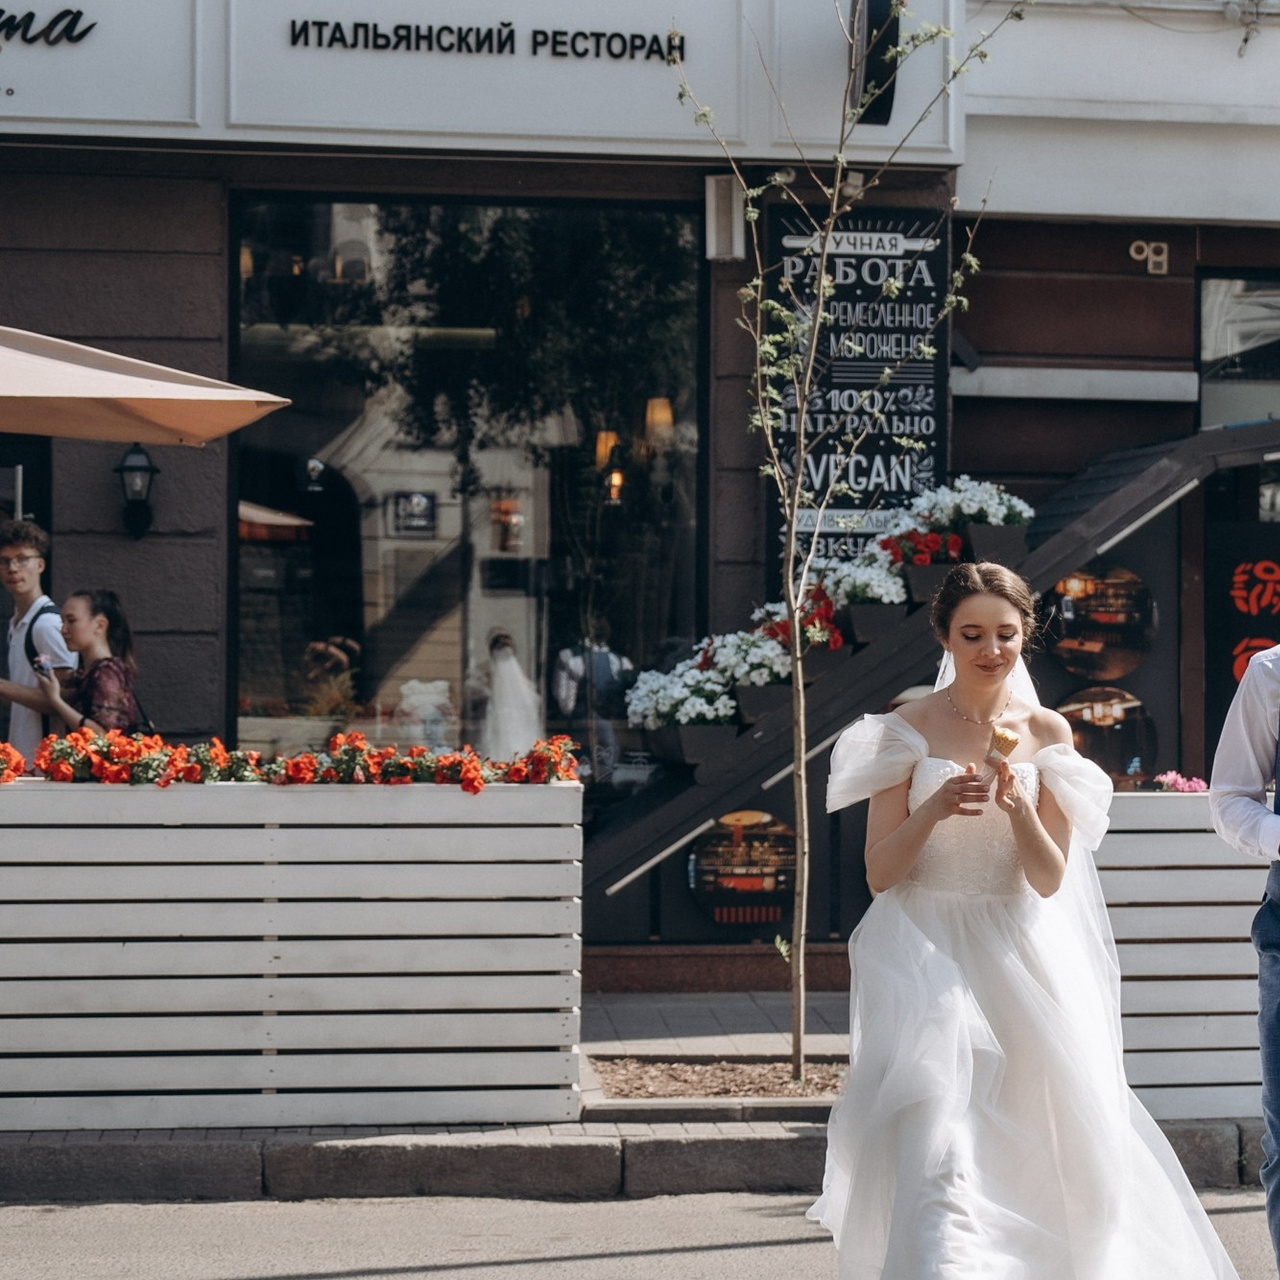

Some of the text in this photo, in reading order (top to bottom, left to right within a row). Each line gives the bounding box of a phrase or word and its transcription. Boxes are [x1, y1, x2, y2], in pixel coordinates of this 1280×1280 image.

[290, 20, 685, 62] ИТАЛЬЯНСКИЙ РЕСТОРАН
[829, 300, 935, 329] РЕМЕСЛЕННОЕ
[829, 331, 935, 360] МОРОЖЕНОЕ
[825, 388, 898, 413] 100%
[805, 453, 913, 493] VEGAN
[812, 536, 878, 559] ВКУ
